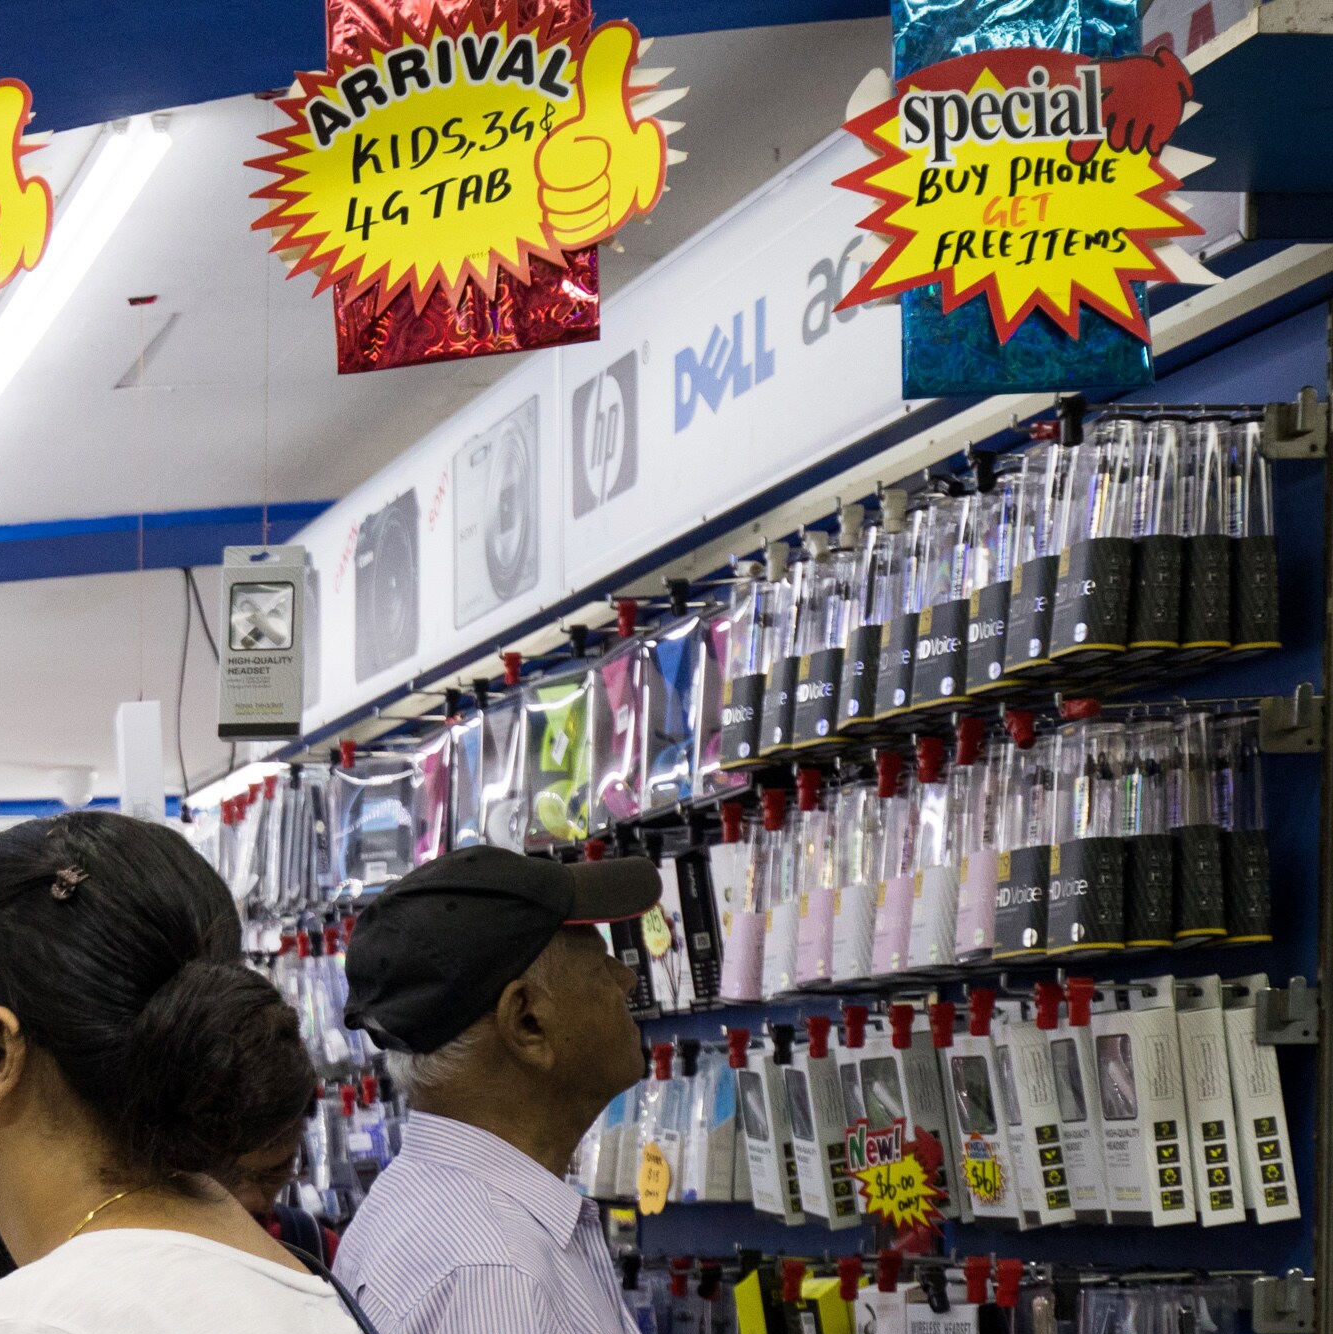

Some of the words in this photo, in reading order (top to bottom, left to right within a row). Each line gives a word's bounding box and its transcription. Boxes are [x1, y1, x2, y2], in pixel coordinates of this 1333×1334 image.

[310, 36, 573, 146] ARRIVAL
[905, 70, 1102, 163] special
[345, 197, 410, 241] 4G
[421, 167, 512, 218] TAB
[916, 164, 990, 207] BUY
[1010, 157, 1120, 196] PHONE
[983, 193, 1053, 228] GET
[675, 296, 776, 434] DELL
[228, 656, 293, 665] HIGH-QUALITY
[228, 666, 271, 675] HEADSET
[848, 1123, 903, 1172] New!
